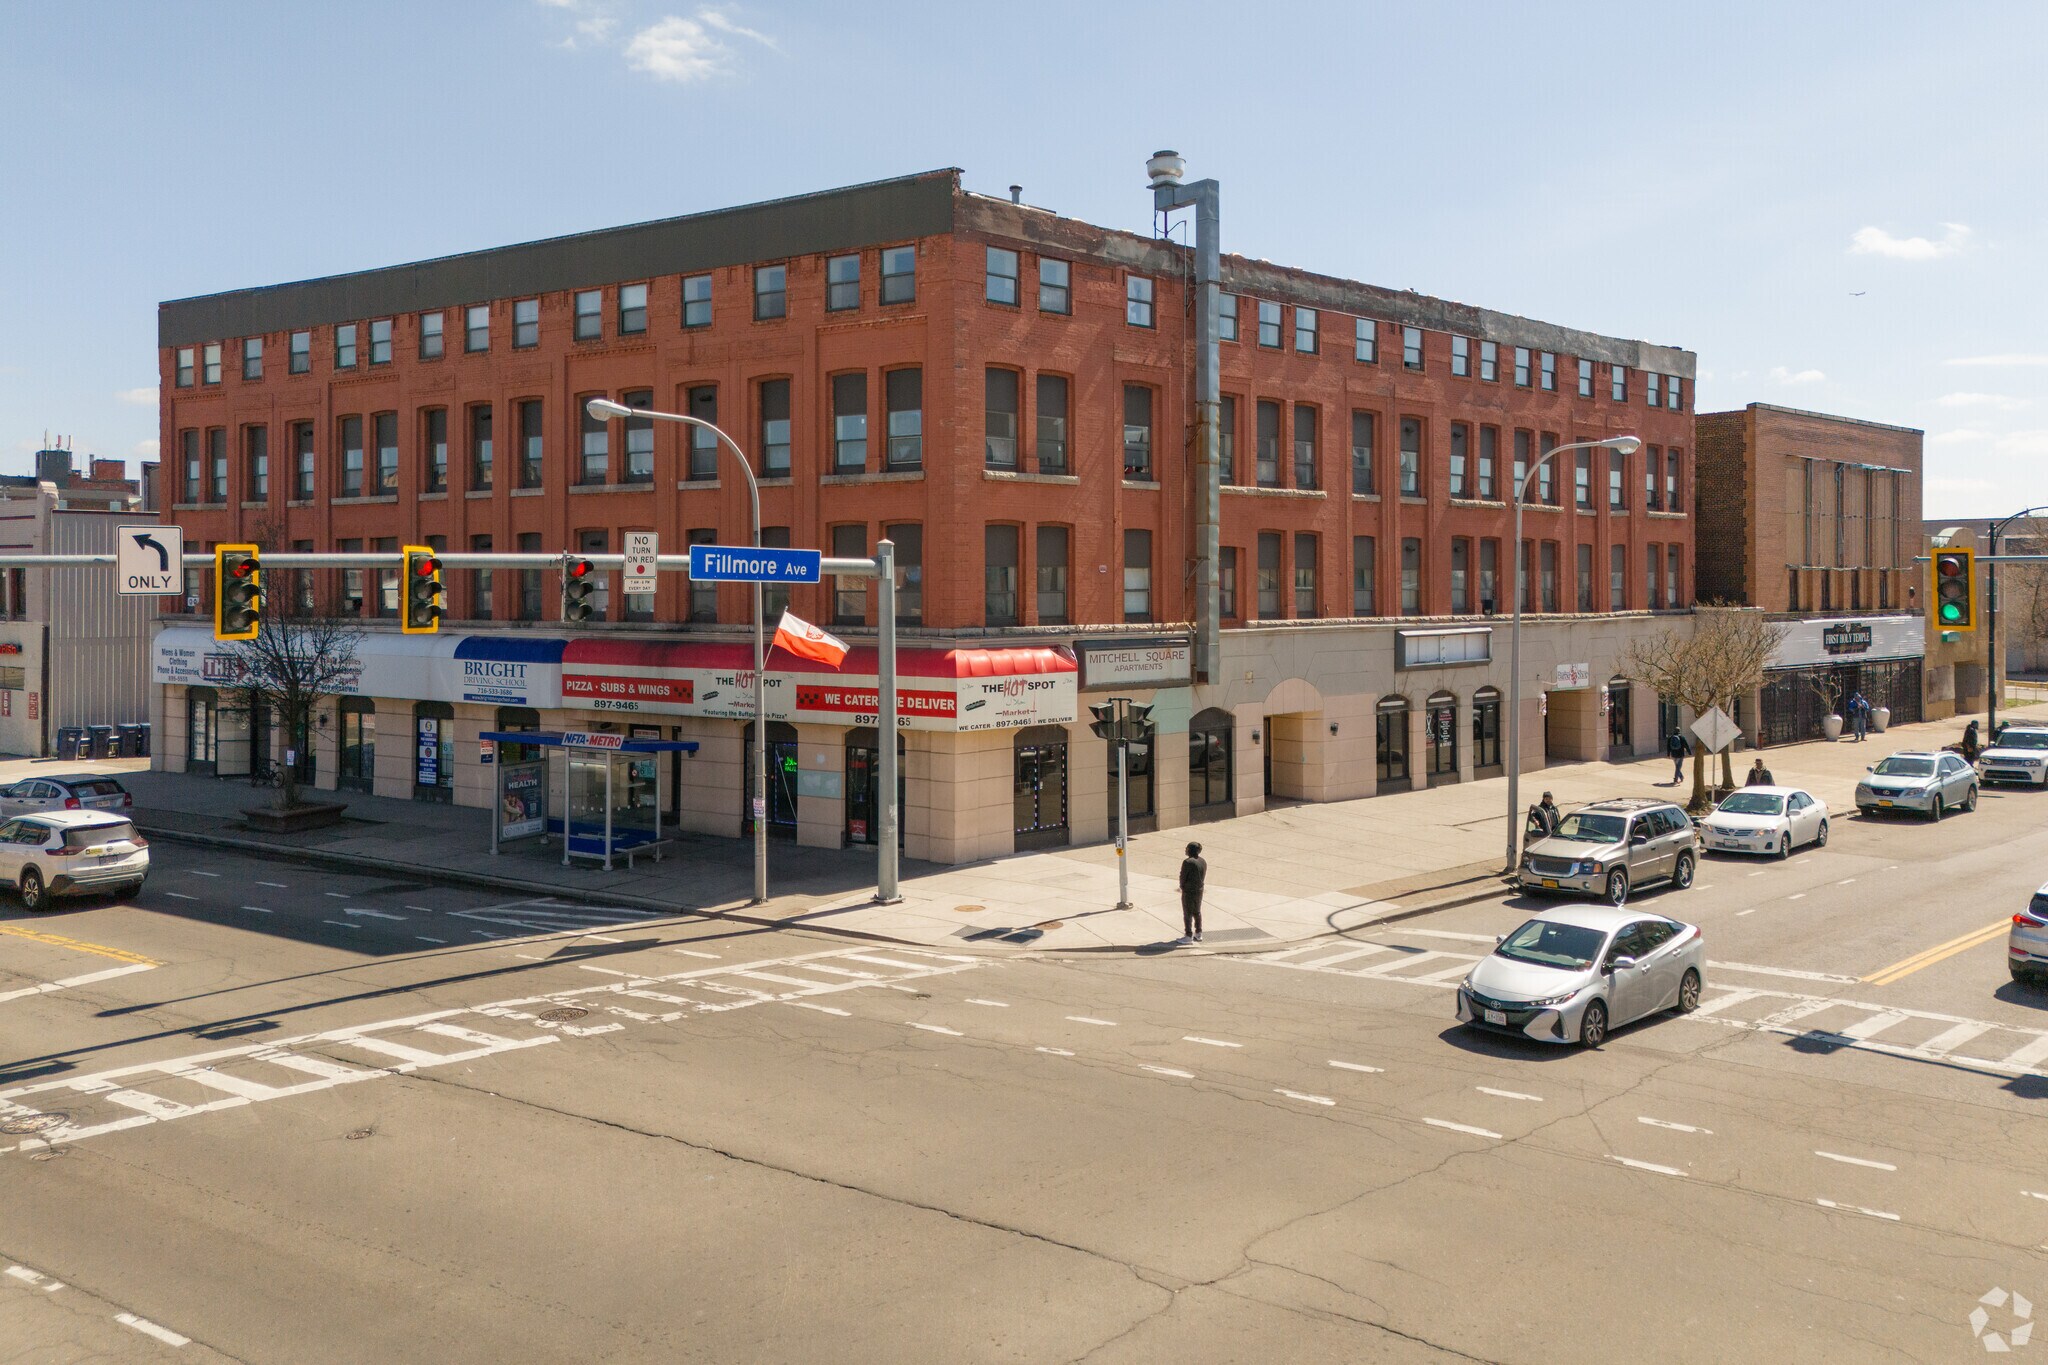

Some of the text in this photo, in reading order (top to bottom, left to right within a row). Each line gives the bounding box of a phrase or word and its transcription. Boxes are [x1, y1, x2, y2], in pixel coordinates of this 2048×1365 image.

[634, 536, 649, 545] NO
[704, 553, 807, 576] Fillmore Ave
[128, 575, 172, 588] ONLY
[1825, 632, 1870, 645] FIRST HOLY TEMPLE
[174, 648, 178, 656] &
[179, 649, 195, 657] Women
[1089, 650, 1185, 664] MITCHELL SQUARE
[169, 657, 188, 667] Clothing
[1114, 663, 1163, 672] APARTMENTS
[157, 665, 199, 676] Phone & Accessories
[464, 661, 528, 678] BRIGHT
[463, 676, 527, 687] DRIVING SCHOOL
[716, 671, 782, 689] THE HOT POT
[566, 681, 670, 696] PIZZA SUBS & WINGS
[982, 684, 1004, 693] THE
[1003, 677, 1028, 697] HOT
[1027, 680, 1056, 691] SPOT
[594, 700, 639, 711] 897-9465
[733, 701, 755, 709] Marke
[824, 693, 841, 705] WE
[844, 694, 879, 706] CATER
[907, 697, 955, 711] DELIVER
[738, 710, 756, 718] Buffalo
[1002, 709, 1030, 717] Market
[854, 715, 911, 727] 897-65
[996, 718, 1032, 728] 897-9465
[508, 778, 538, 790] HEALTH
